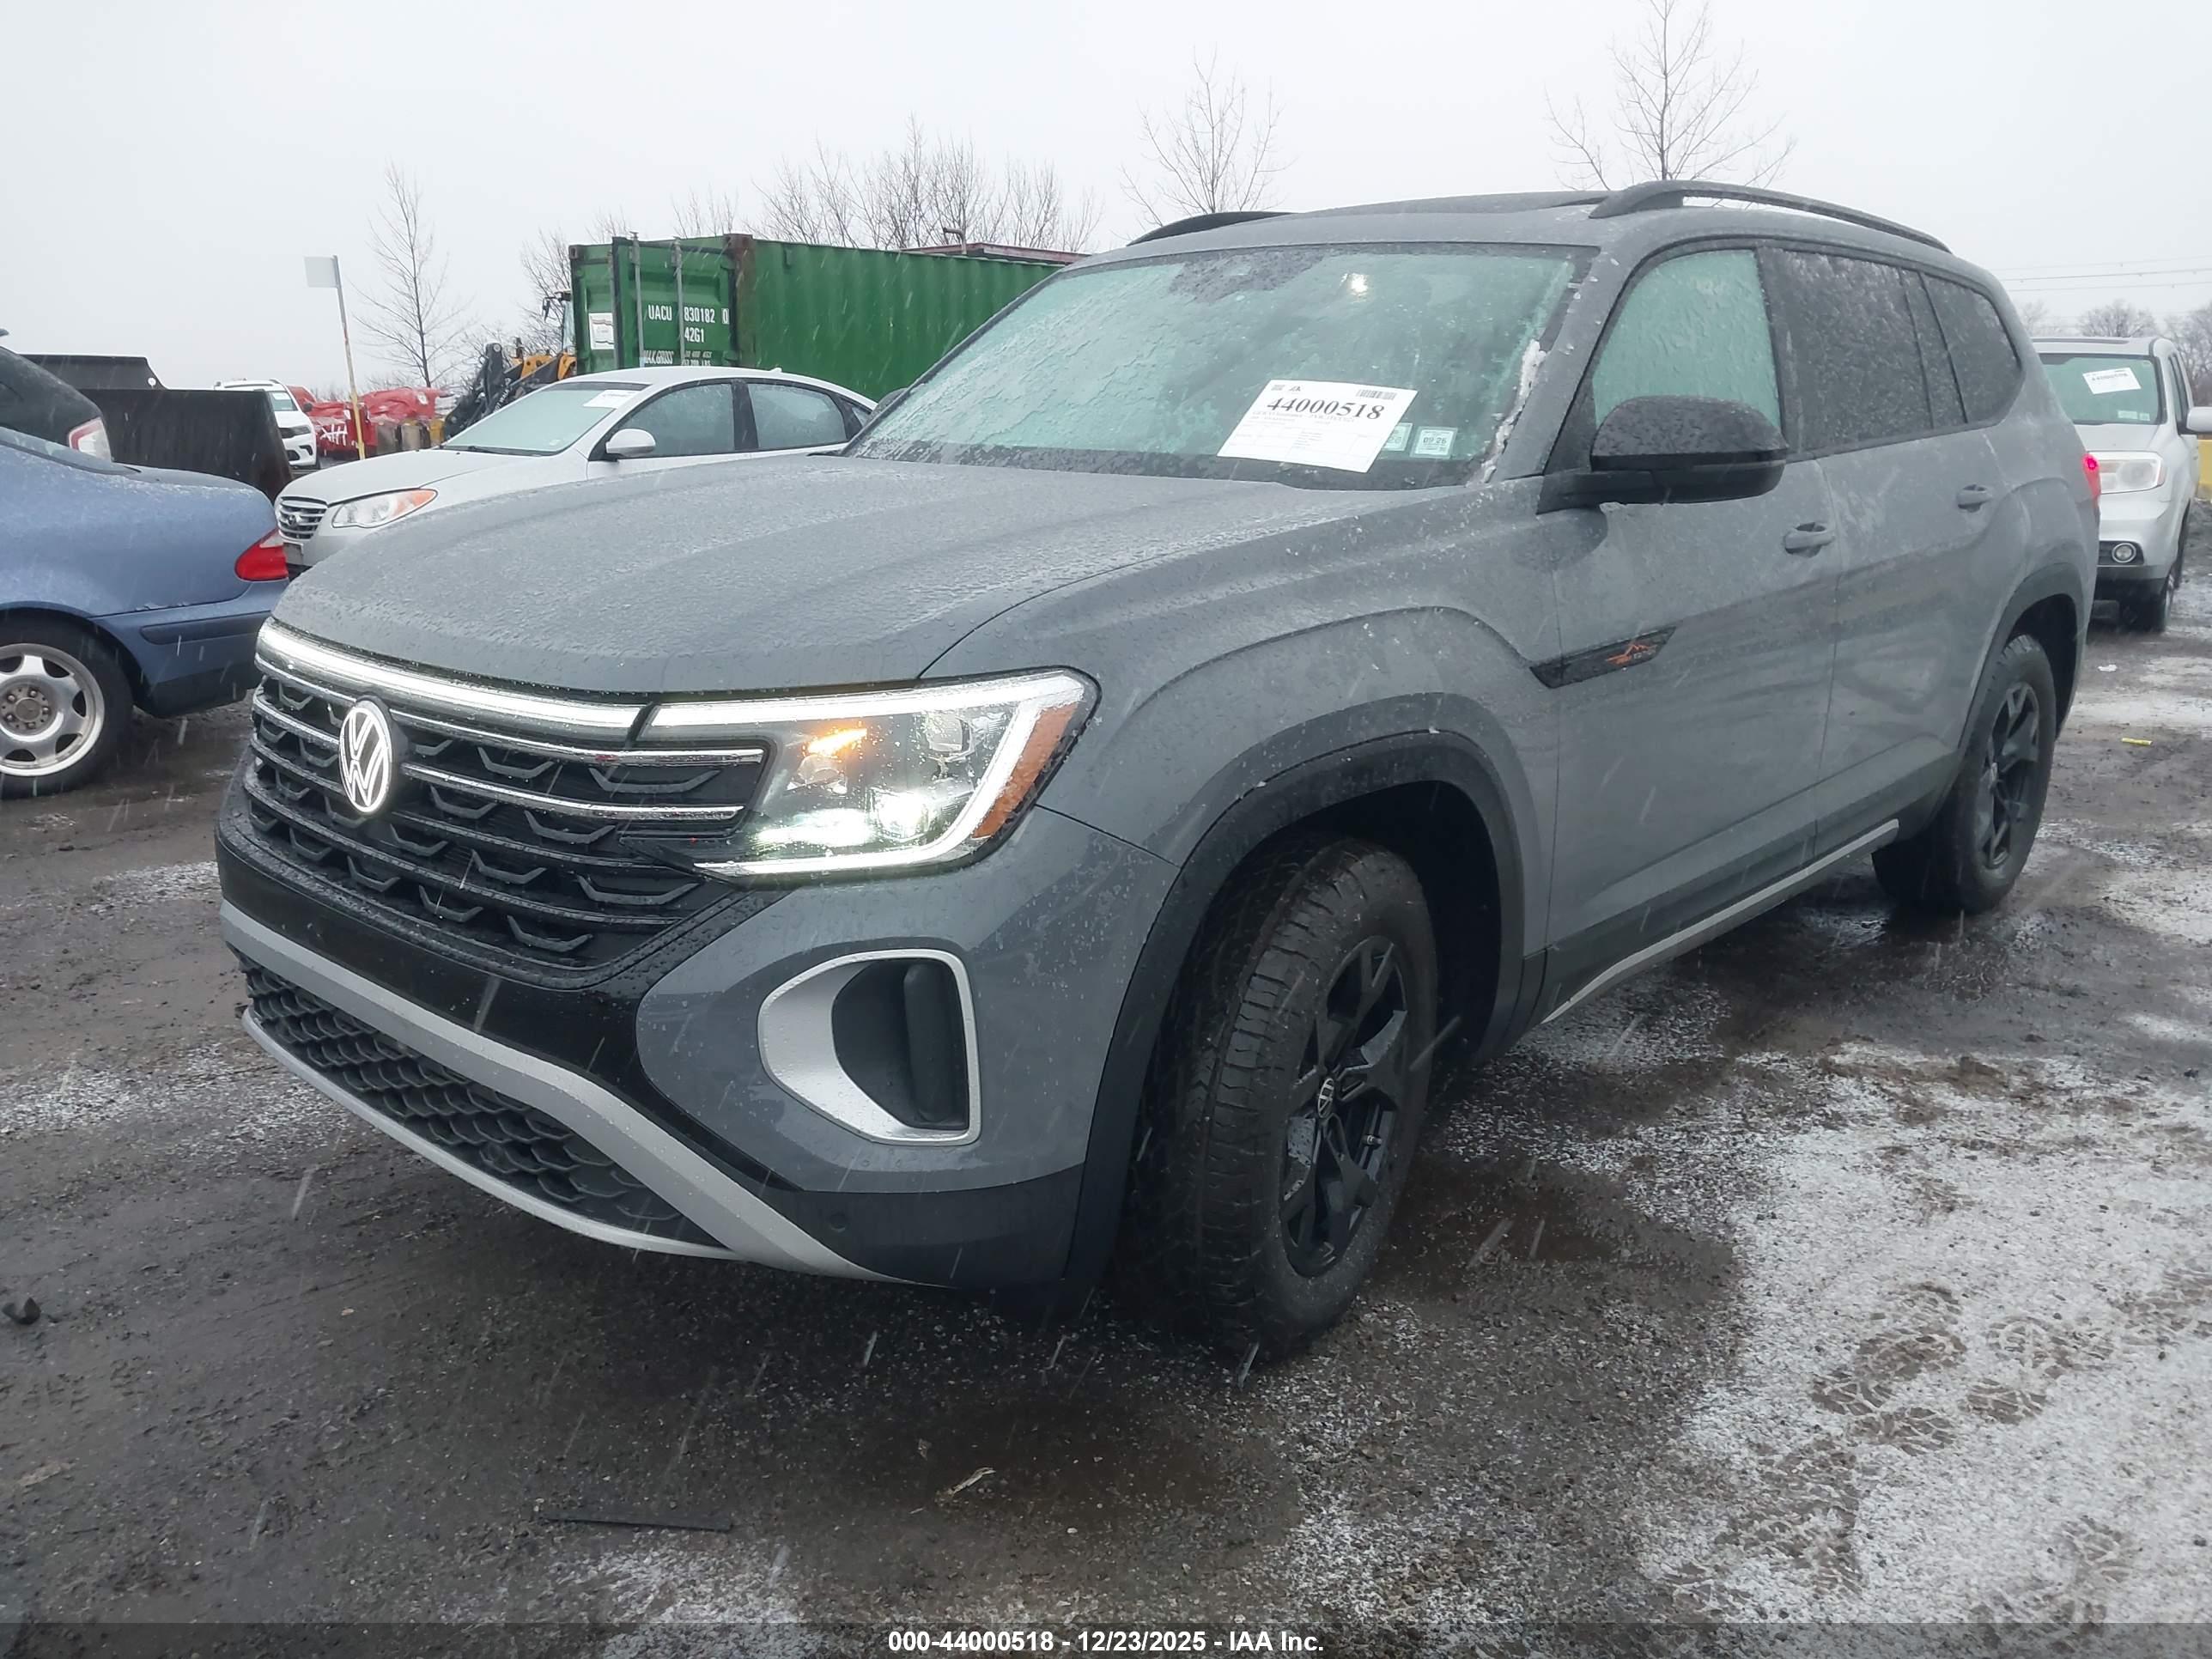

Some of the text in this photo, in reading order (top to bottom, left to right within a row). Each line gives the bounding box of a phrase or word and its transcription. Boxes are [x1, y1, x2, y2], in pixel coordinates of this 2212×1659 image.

[648, 305, 672, 321] UACU
[684, 307, 715, 323] 830182
[684, 327, 704, 343] 42G1
[1267, 398, 1384, 419] 44000518
